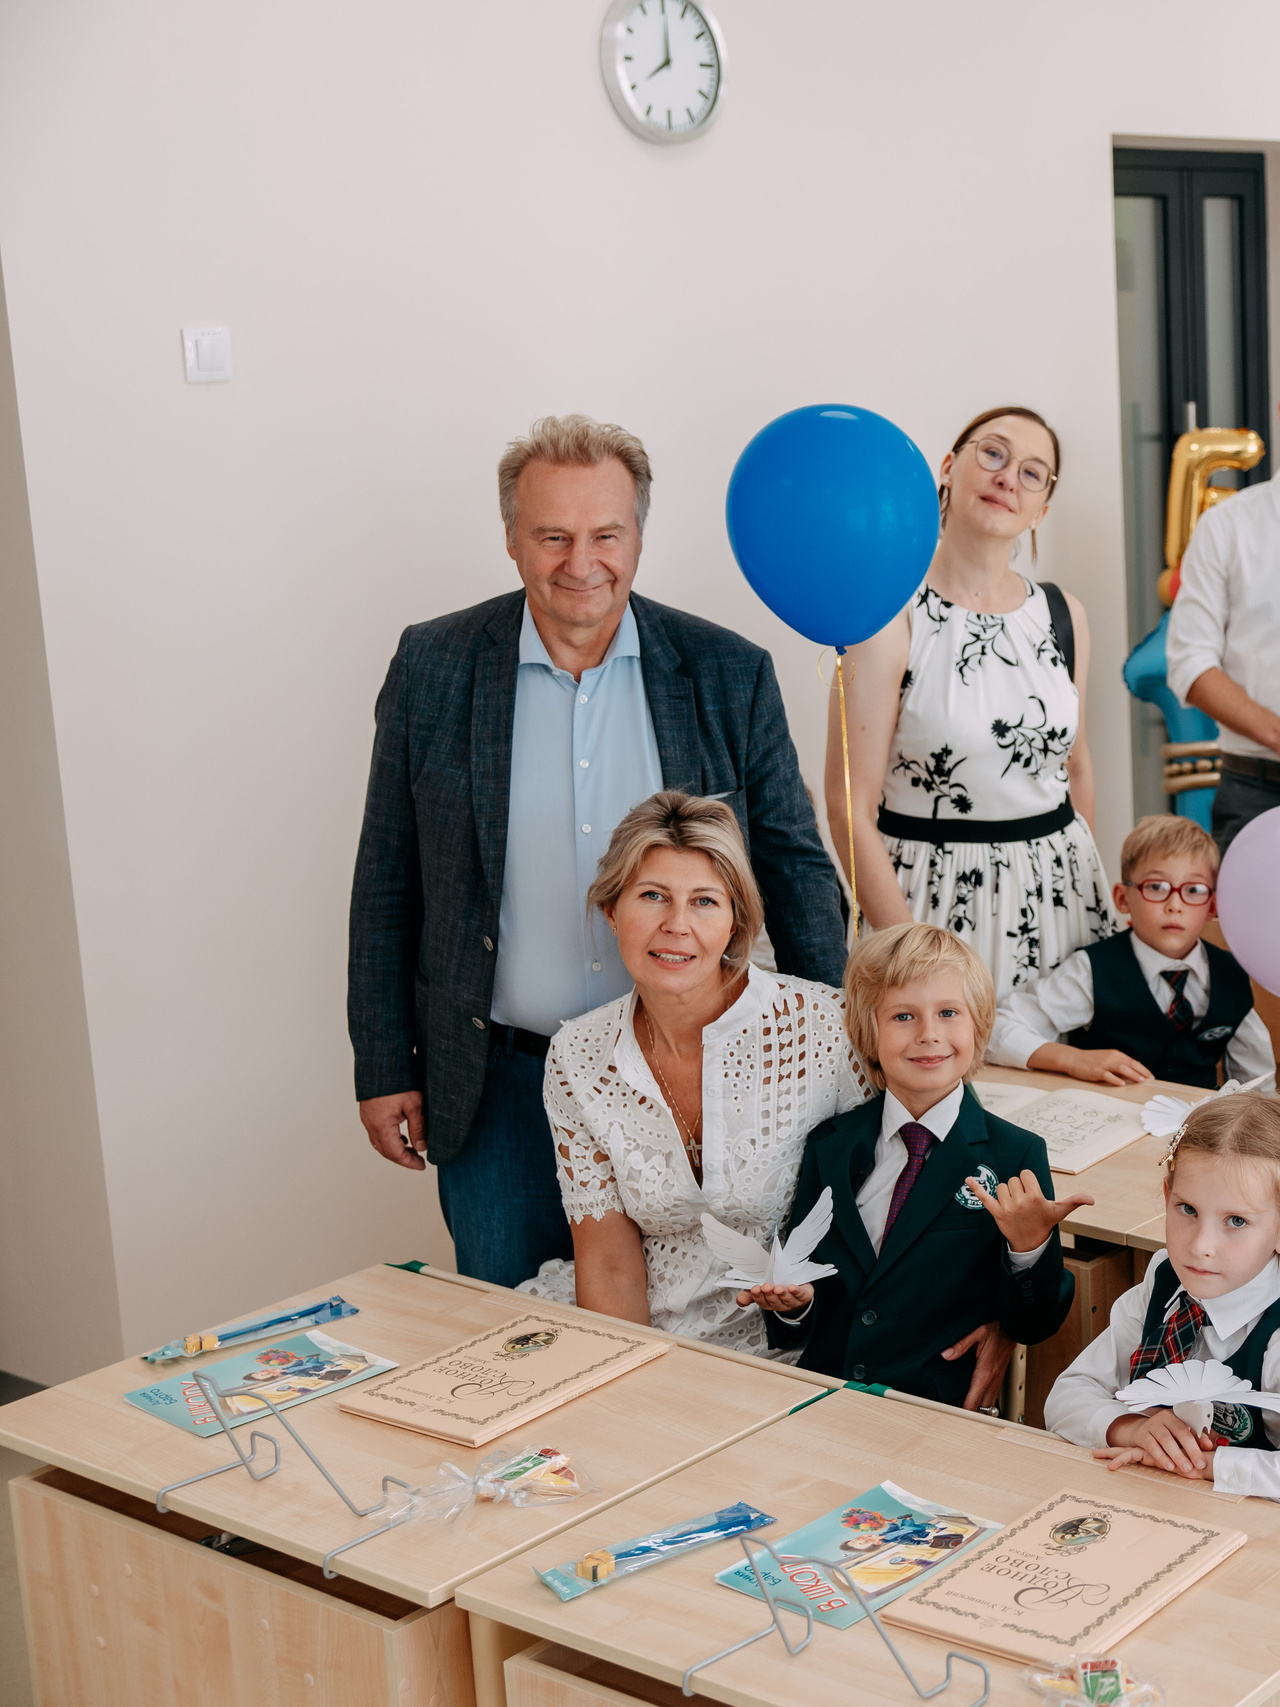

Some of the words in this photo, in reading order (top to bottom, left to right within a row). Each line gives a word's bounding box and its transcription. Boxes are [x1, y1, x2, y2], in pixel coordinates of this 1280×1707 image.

[448, 1359, 507, 1378] СЛОВО
[140, 1391, 162, 1406] Агния
[150, 1388, 178, 1405] Барто
[193, 1416, 218, 1425] В
[1008, 1548, 1044, 1561] Азбука
[995, 1554, 1071, 1580] СЛОВО
[817, 1598, 849, 1612] В
[944, 1590, 998, 1610] Ушинский
